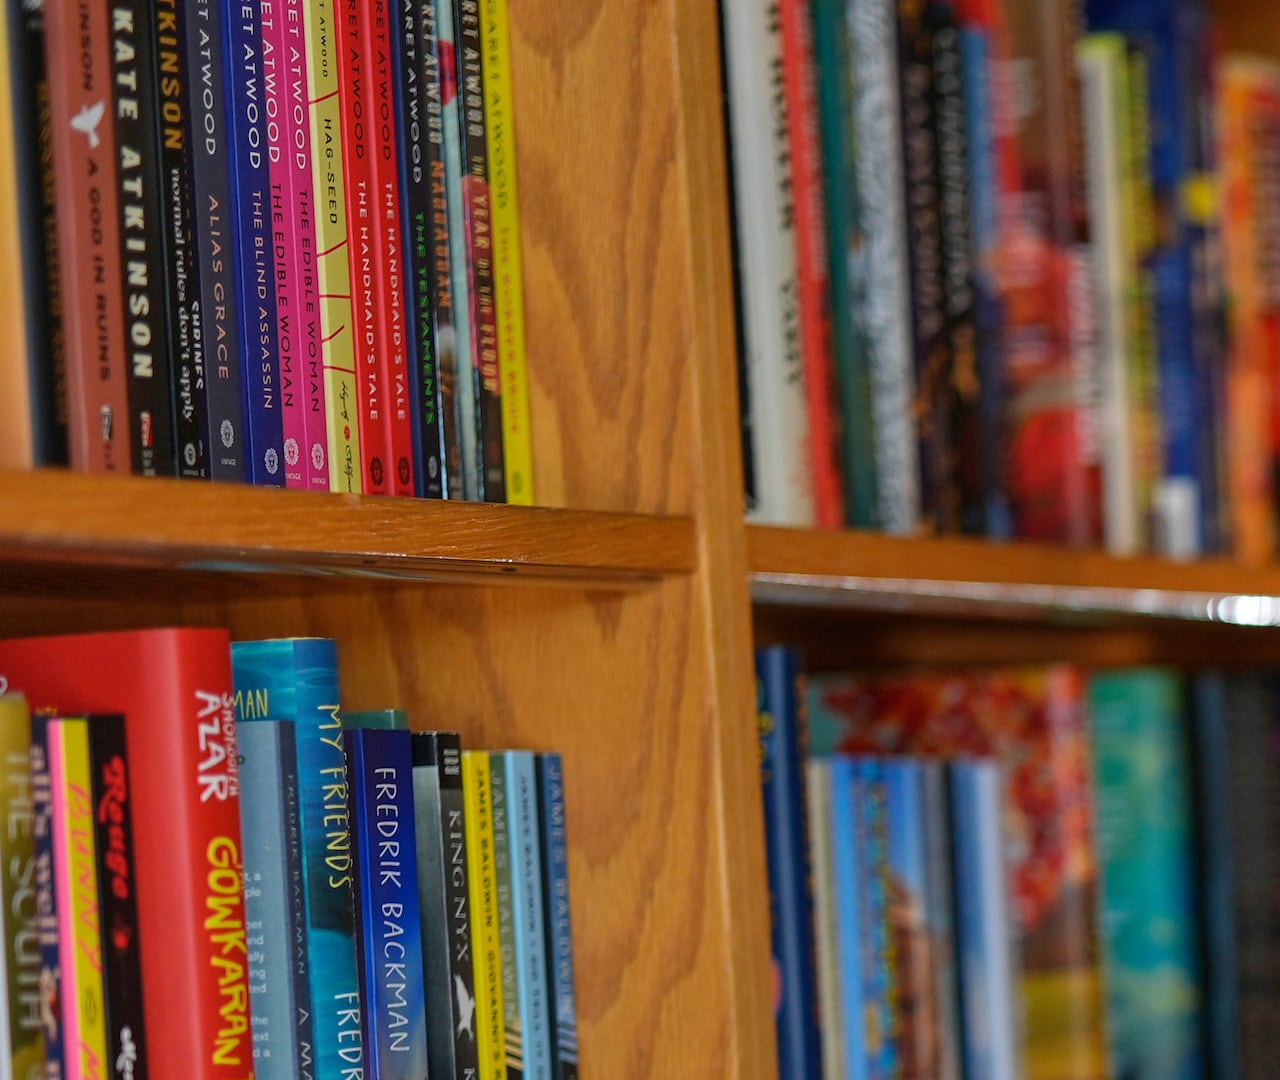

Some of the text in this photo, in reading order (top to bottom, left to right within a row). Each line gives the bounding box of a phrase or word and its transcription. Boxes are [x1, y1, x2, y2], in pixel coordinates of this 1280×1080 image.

[199, 29, 216, 155] ATWOOD
[243, 43, 261, 169] ATWOOD
[262, 39, 281, 163] ATWOOD
[289, 46, 306, 170] ATWOOD
[318, 16, 329, 78] ATWOOD
[349, 47, 365, 160] ATWOOD
[375, 51, 392, 161] ATWOOD
[423, 52, 444, 145] ATWOOD
[464, 47, 484, 138] ATWOOD
[323, 117, 338, 225] HAG-SEED
[407, 66, 423, 184] ATWOOD
[490, 90, 510, 210] ATWOOD
[112, 8, 154, 378] KATE ATKINSON
[170, 168, 186, 243] normal
[471, 193, 491, 250] YEAR
[87, 187, 112, 382] GOD IN RUINS
[175, 248, 188, 302] rules
[177, 306, 191, 361] don't
[208, 194, 231, 380] ALIAS GRACE
[252, 190, 274, 410] THE BLIND ASSASSIN
[271, 183, 294, 408] THE EDIBLE WOMAN
[298, 189, 321, 413] THE EDIBLE WOMAN
[357, 180, 379, 421] THE HANDMAID'S TALE
[385, 181, 406, 421] THE HANDMAID'S TALE
[415, 211, 436, 425] THE TESTAMENTS
[179, 365, 193, 424] apply
[31, 745, 56, 838] all's
[195, 689, 229, 802] AZAR
[316, 704, 353, 889] MY FRIENDS
[476, 768, 488, 832] JAMES
[66, 781, 104, 973] BUNNY
[98, 755, 129, 899] Rouge
[285, 773, 306, 975] FREDRIK BACKMAN
[448, 809, 471, 962] KING NYX
[479, 836, 493, 928] BALDWIN
[35, 855, 59, 945] well
[203, 835, 250, 1066] GOWKARAN
[374, 766, 411, 1052] FREDRIK BACKMAN
[491, 770, 518, 1022] JAMES BALDWIN
[547, 765, 576, 1016] JAMES BALDWIN
[298, 1007, 310, 1026] A
